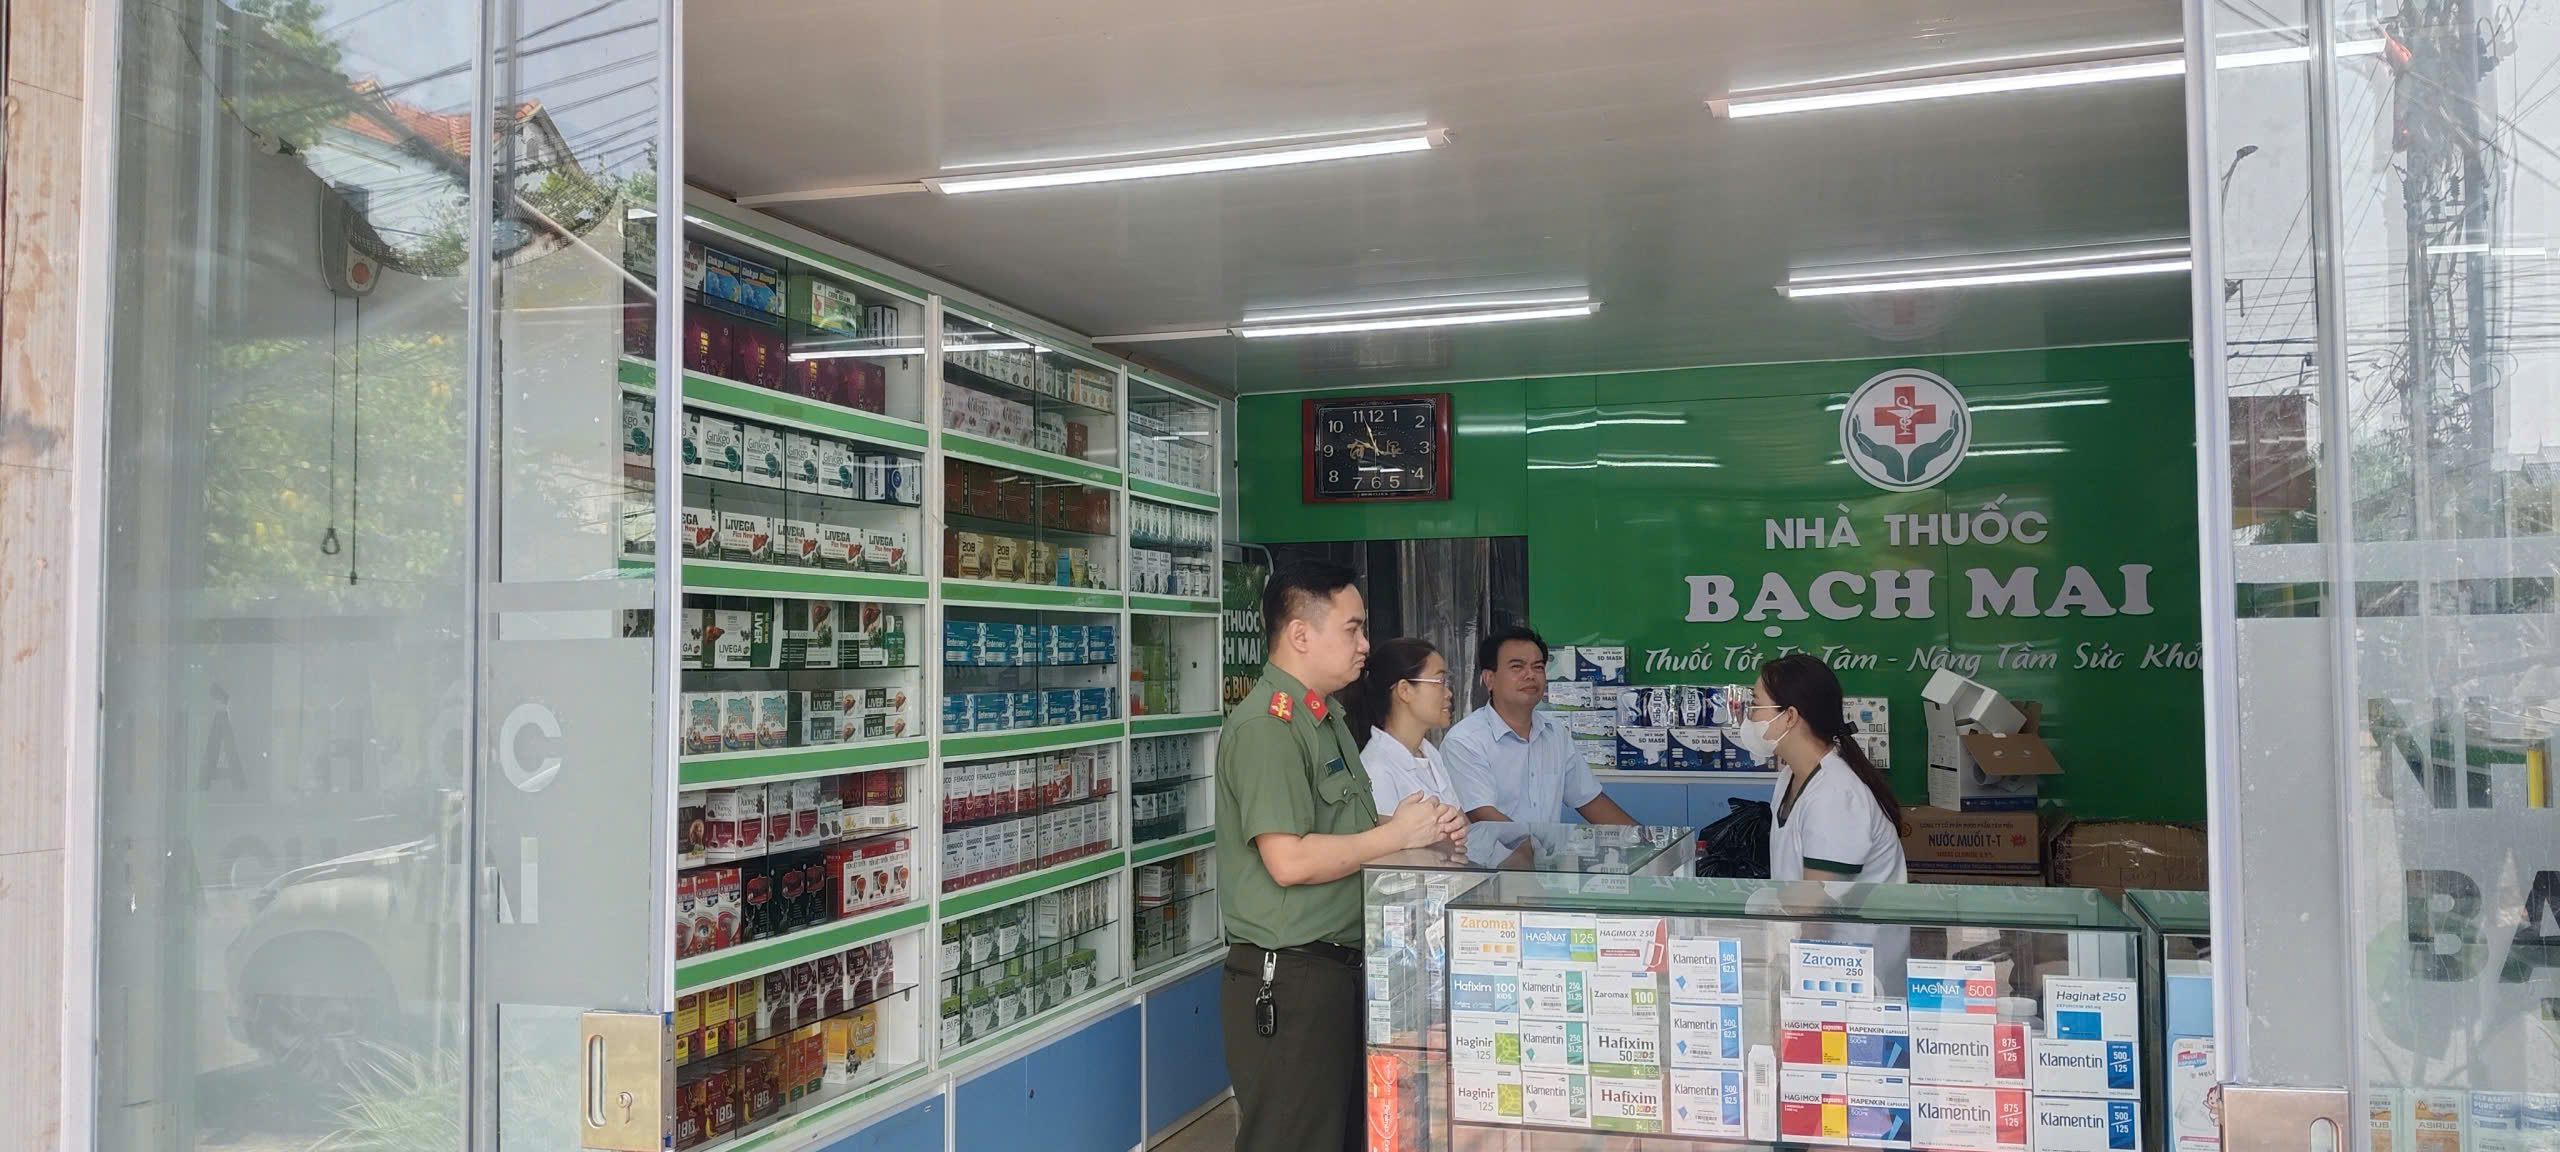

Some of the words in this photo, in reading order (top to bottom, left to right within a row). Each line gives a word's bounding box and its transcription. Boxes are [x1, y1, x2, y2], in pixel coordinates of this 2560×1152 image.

[1352, 410, 1364, 423] 11
[1368, 409, 1384, 423] 12
[1392, 409, 1398, 422] 1
[1415, 415, 1425, 428] 2
[1328, 420, 1344, 433] 10
[706, 430, 731, 448] Ginkgo
[747, 438, 771, 455] Ginkgo
[1323, 445, 1334, 458] 9
[1419, 440, 1430, 454] 3
[823, 451, 844, 465] Ginkgo
[1329, 470, 1339, 483] 8
[1414, 467, 1424, 480] 4
[1352, 477, 1363, 490] 7
[1371, 476, 1381, 489] 6
[1389, 475, 1400, 489] 5
[725, 518, 756, 532] LIVEGA
[1765, 503, 1861, 549] NHÀ
[1884, 493, 2048, 546] THUỐC
[824, 530, 851, 543] LIVEGA
[868, 535, 894, 547] LIVEGA
[1684, 569, 1935, 637] BẠCH
[1965, 563, 2155, 618] MAI
[1223, 601, 1260, 632] THUỐC
[754, 612, 764, 644] LIVER
[718, 644, 742, 654] LIVEGA
[1238, 637, 1261, 665] MAI
[1644, 641, 1713, 673] Thuốc
[1723, 641, 1762, 673] Tốt
[1821, 643, 1878, 672] Tâm
[1906, 646, 1982, 679] Nâng
[1998, 642, 2058, 671] Tầm
[2073, 641, 2125, 671] Sức
[813, 700, 832, 711] LIVER
[867, 697, 884, 708] LIVER
[813, 729, 832, 740] LIVER
[866, 726, 884, 737] LIVER
[1928, 832, 1956, 847] NƯỚC
[1956, 831, 1985, 848] MUỐI
[1987, 834, 2002, 848] T-T
[1460, 916, 1516, 930] Zaromax
[1499, 930, 1516, 939] 200
[1574, 933, 1594, 945] 125
[1599, 929, 1637, 938] HAGIMOX
[1639, 930, 1655, 938] 250
[1673, 953, 1717, 966] Klamentin
[1722, 953, 1736, 962] 500
[1802, 952, 1863, 968] Zaromax
[1845, 968, 1864, 977] 250
[1454, 980, 1492, 992] Hafixim
[1495, 983, 1516, 993] 100
[1522, 981, 1563, 993] Klamentin
[1968, 985, 1994, 997] 500
[1594, 990, 1629, 999] Zaromax
[1634, 991, 1654, 1004] 100
[2056, 991, 2101, 1002] Haginat
[2102, 992, 2127, 1002] 250
[1674, 1018, 1718, 1031] Klamentin
[1723, 1019, 1737, 1027] 500
[1784, 1022, 1820, 1030] HAGIMOX
[1455, 1036, 1493, 1049] Haginir
[1523, 1032, 1564, 1045] Klamentin
[1598, 1035, 1654, 1050] Hafixim
[2001, 1038, 2017, 1048] 875
[1916, 1038, 1989, 1057] Klamentin
[1476, 1050, 1491, 1060] 125
[1619, 1050, 1633, 1062] 50
[2003, 1053, 2018, 1062] 125
[2039, 1052, 2103, 1069] Klamentin
[2113, 1052, 2128, 1060] 500
[2114, 1064, 2128, 1073] 125
[1458, 1087, 1496, 1100] Haginir
[1525, 1084, 1567, 1097] Klamentin
[1674, 1084, 1719, 1097] Klamentin
[1724, 1085, 1737, 1093] 500
[1601, 1089, 1657, 1105] Hafixim
[1784, 1093, 1820, 1102] HAGIMOX
[1478, 1101, 1494, 1111] 125
[1622, 1104, 1635, 1116] 50
[1918, 1102, 1991, 1122] Klamentin
[2003, 1103, 2019, 1113] 875
[2004, 1118, 2020, 1127] 125
[2040, 1112, 2105, 1128] Klamentin
[2114, 1112, 2129, 1120] 500
[2115, 1124, 2129, 1133] 125
